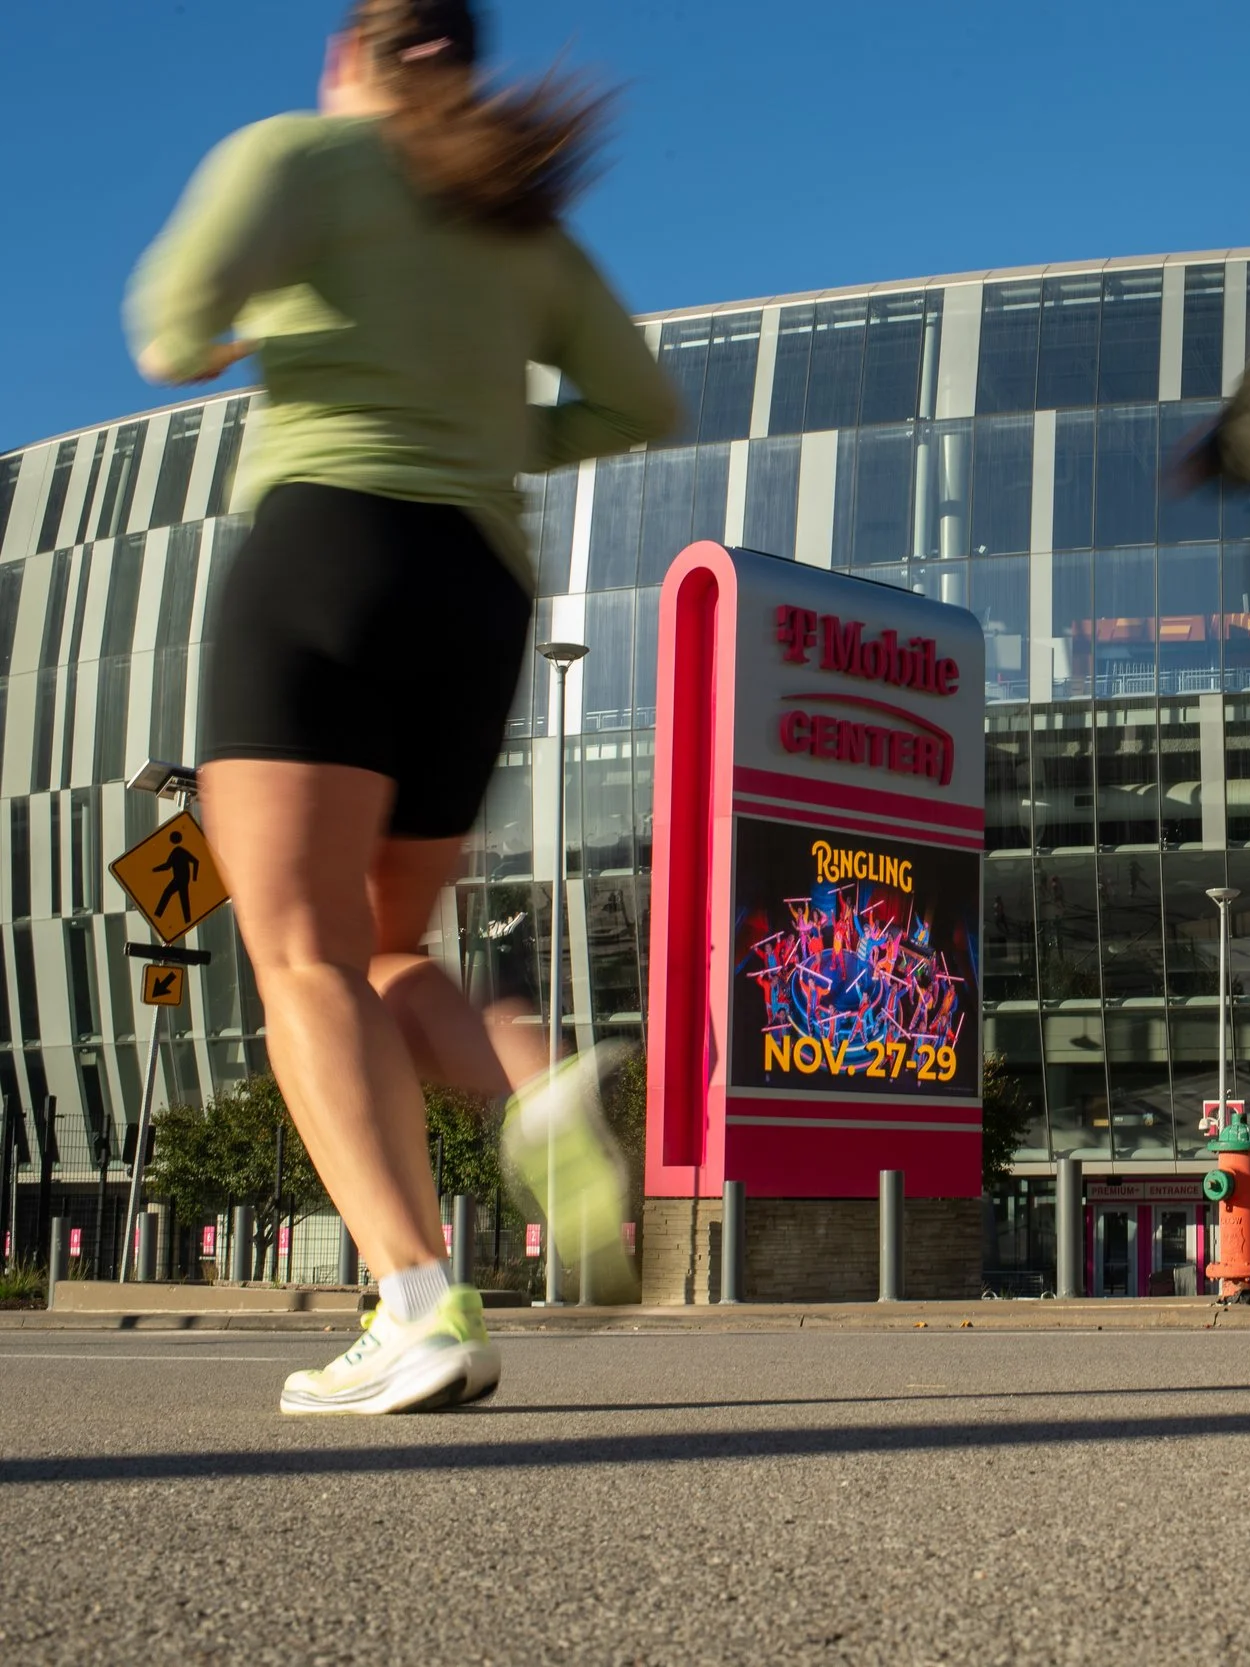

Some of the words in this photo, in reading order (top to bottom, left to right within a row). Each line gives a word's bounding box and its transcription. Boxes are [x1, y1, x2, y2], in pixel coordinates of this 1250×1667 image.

[779, 709, 940, 778] CENTER
[811, 840, 913, 894] RINGLING
[764, 1033, 857, 1077] NOV.
[865, 1040, 958, 1082] 27-29
[1149, 1184, 1200, 1196] ENTRANCE
